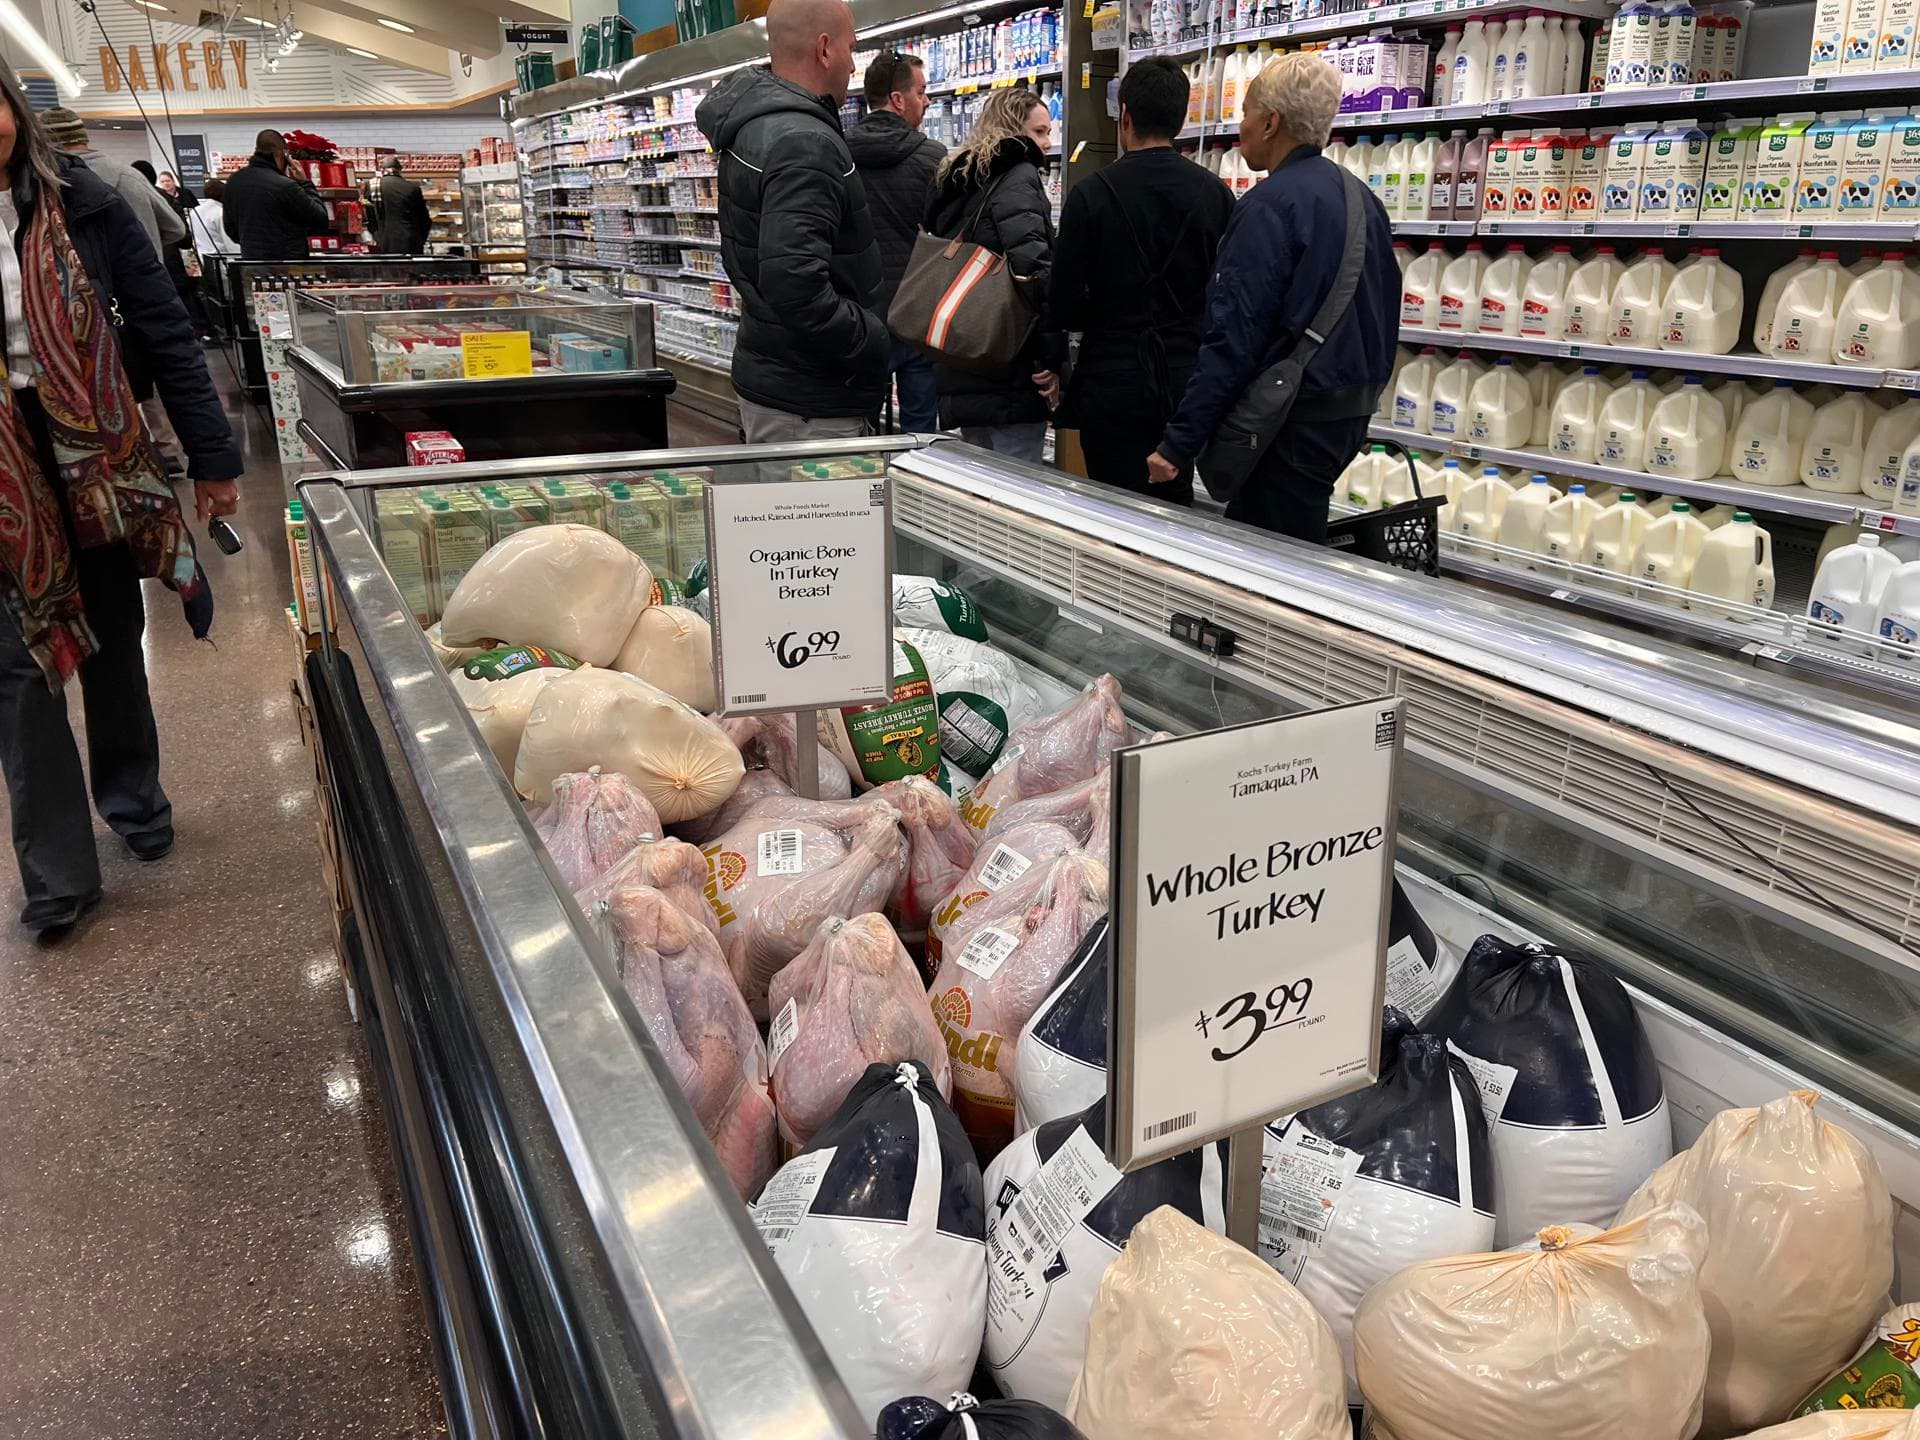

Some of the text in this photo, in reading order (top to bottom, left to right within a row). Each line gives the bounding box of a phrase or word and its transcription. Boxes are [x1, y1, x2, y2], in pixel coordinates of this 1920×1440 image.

[98, 40, 247, 93] BAKERY
[1356, 66, 1374, 76] Milk
[768, 512, 795, 521] Raised,
[797, 512, 811, 520] and
[811, 510, 848, 519] Harvested
[749, 546, 856, 565] Organic Bone
[770, 565, 839, 581] In Turkey
[779, 584, 833, 599] Breast
[959, 594, 970, 622] Turkey
[883, 710, 912, 722] TURKEY
[853, 718, 882, 731] BREAST
[890, 730, 918, 739] NATURAL
[1237, 756, 1312, 779] Kochs Turkey Farm
[1229, 766, 1319, 799] Tamaqua, PA
[1147, 826, 1384, 907] Whole Bronze
[1207, 888, 1325, 940] Turkey
[1298, 1015, 1326, 1029] POUND
[986, 1218, 1004, 1264] Young
[1269, 1237, 1292, 1251] WHOLE
